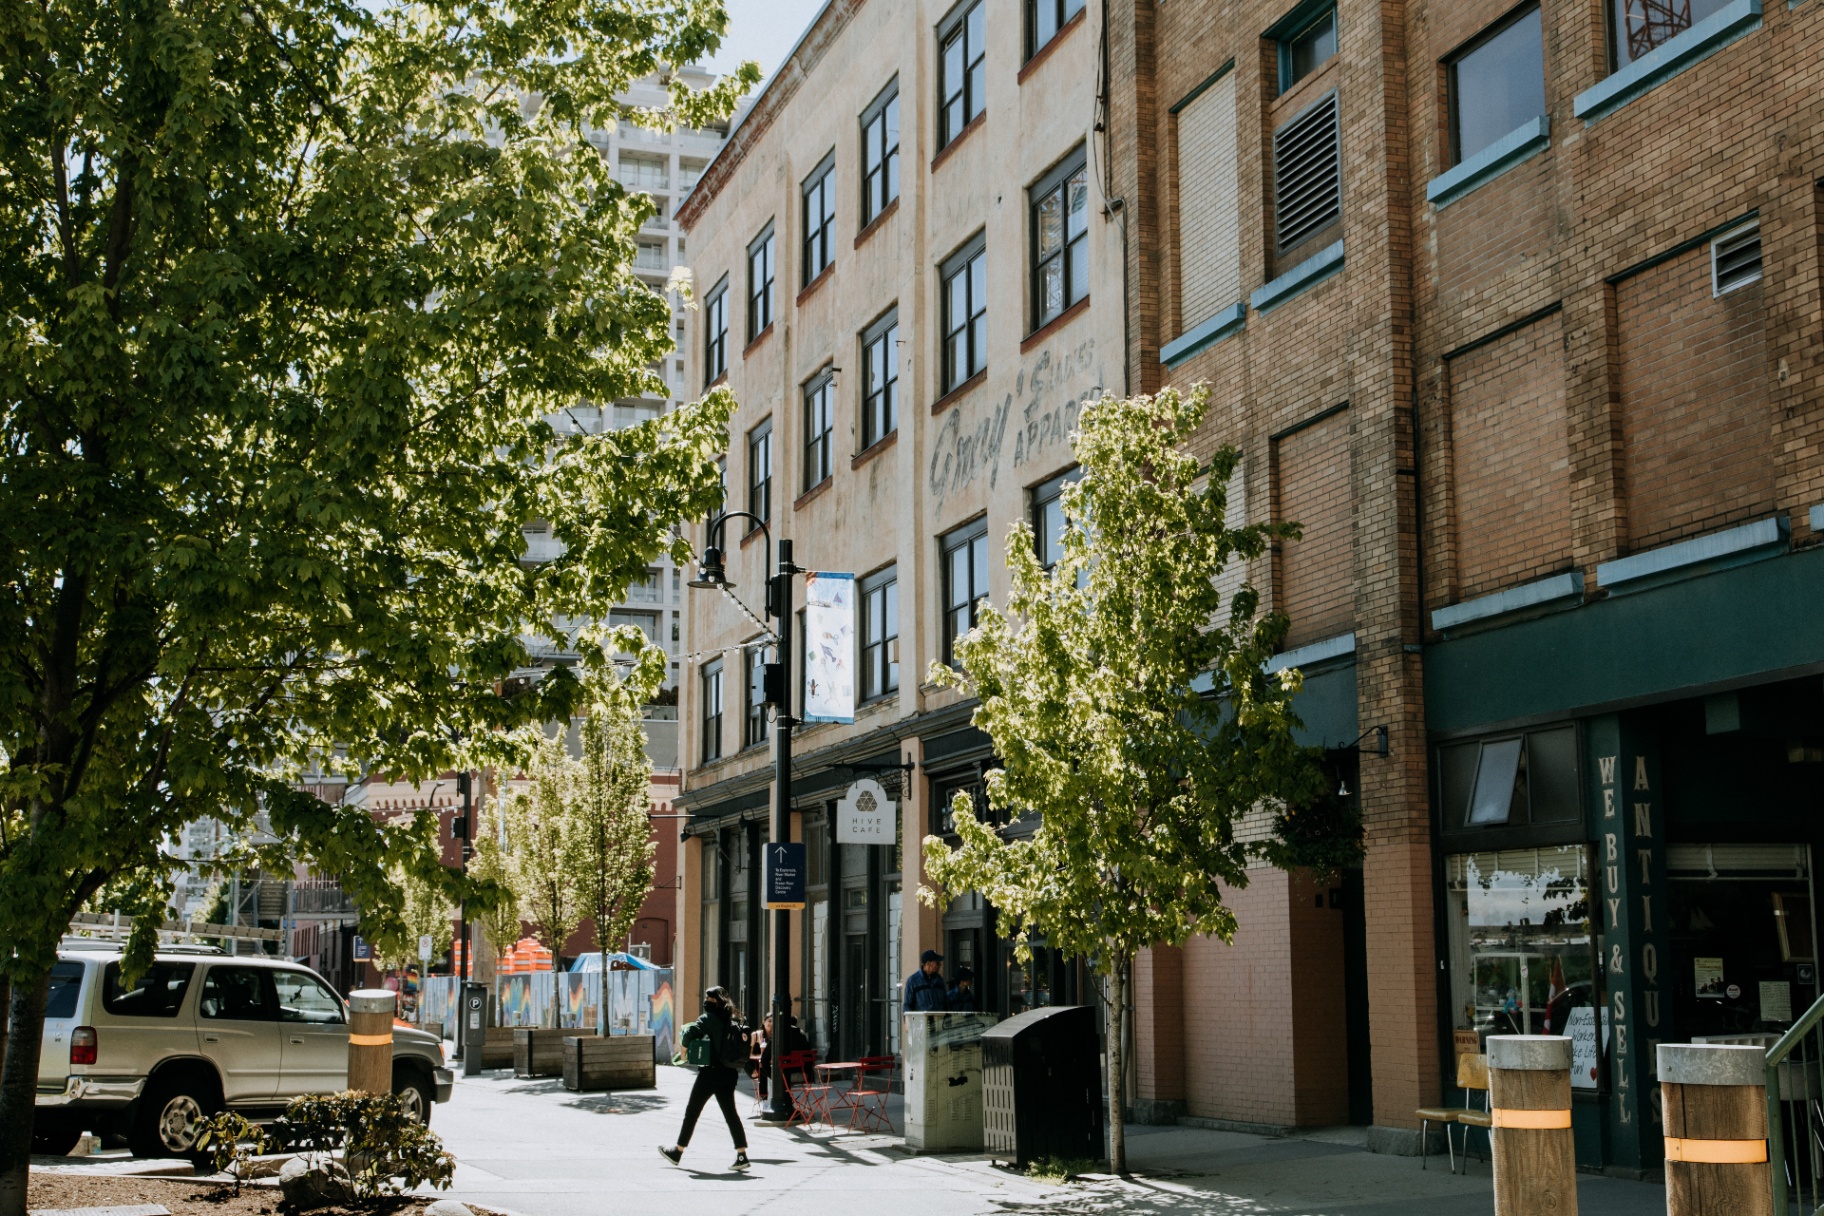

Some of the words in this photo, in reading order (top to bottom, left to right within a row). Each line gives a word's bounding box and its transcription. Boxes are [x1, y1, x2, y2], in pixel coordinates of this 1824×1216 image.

[1599, 755, 1617, 818] WE
[852, 826, 881, 834] CAFE
[1604, 833, 1622, 929] BUY
[1610, 944, 1624, 974] &
[1633, 755, 1663, 1125] ANTIQUES
[472, 999, 479, 1008] P
[1584, 1044, 1597, 1059] Life
[1613, 990, 1632, 1124] SELL
